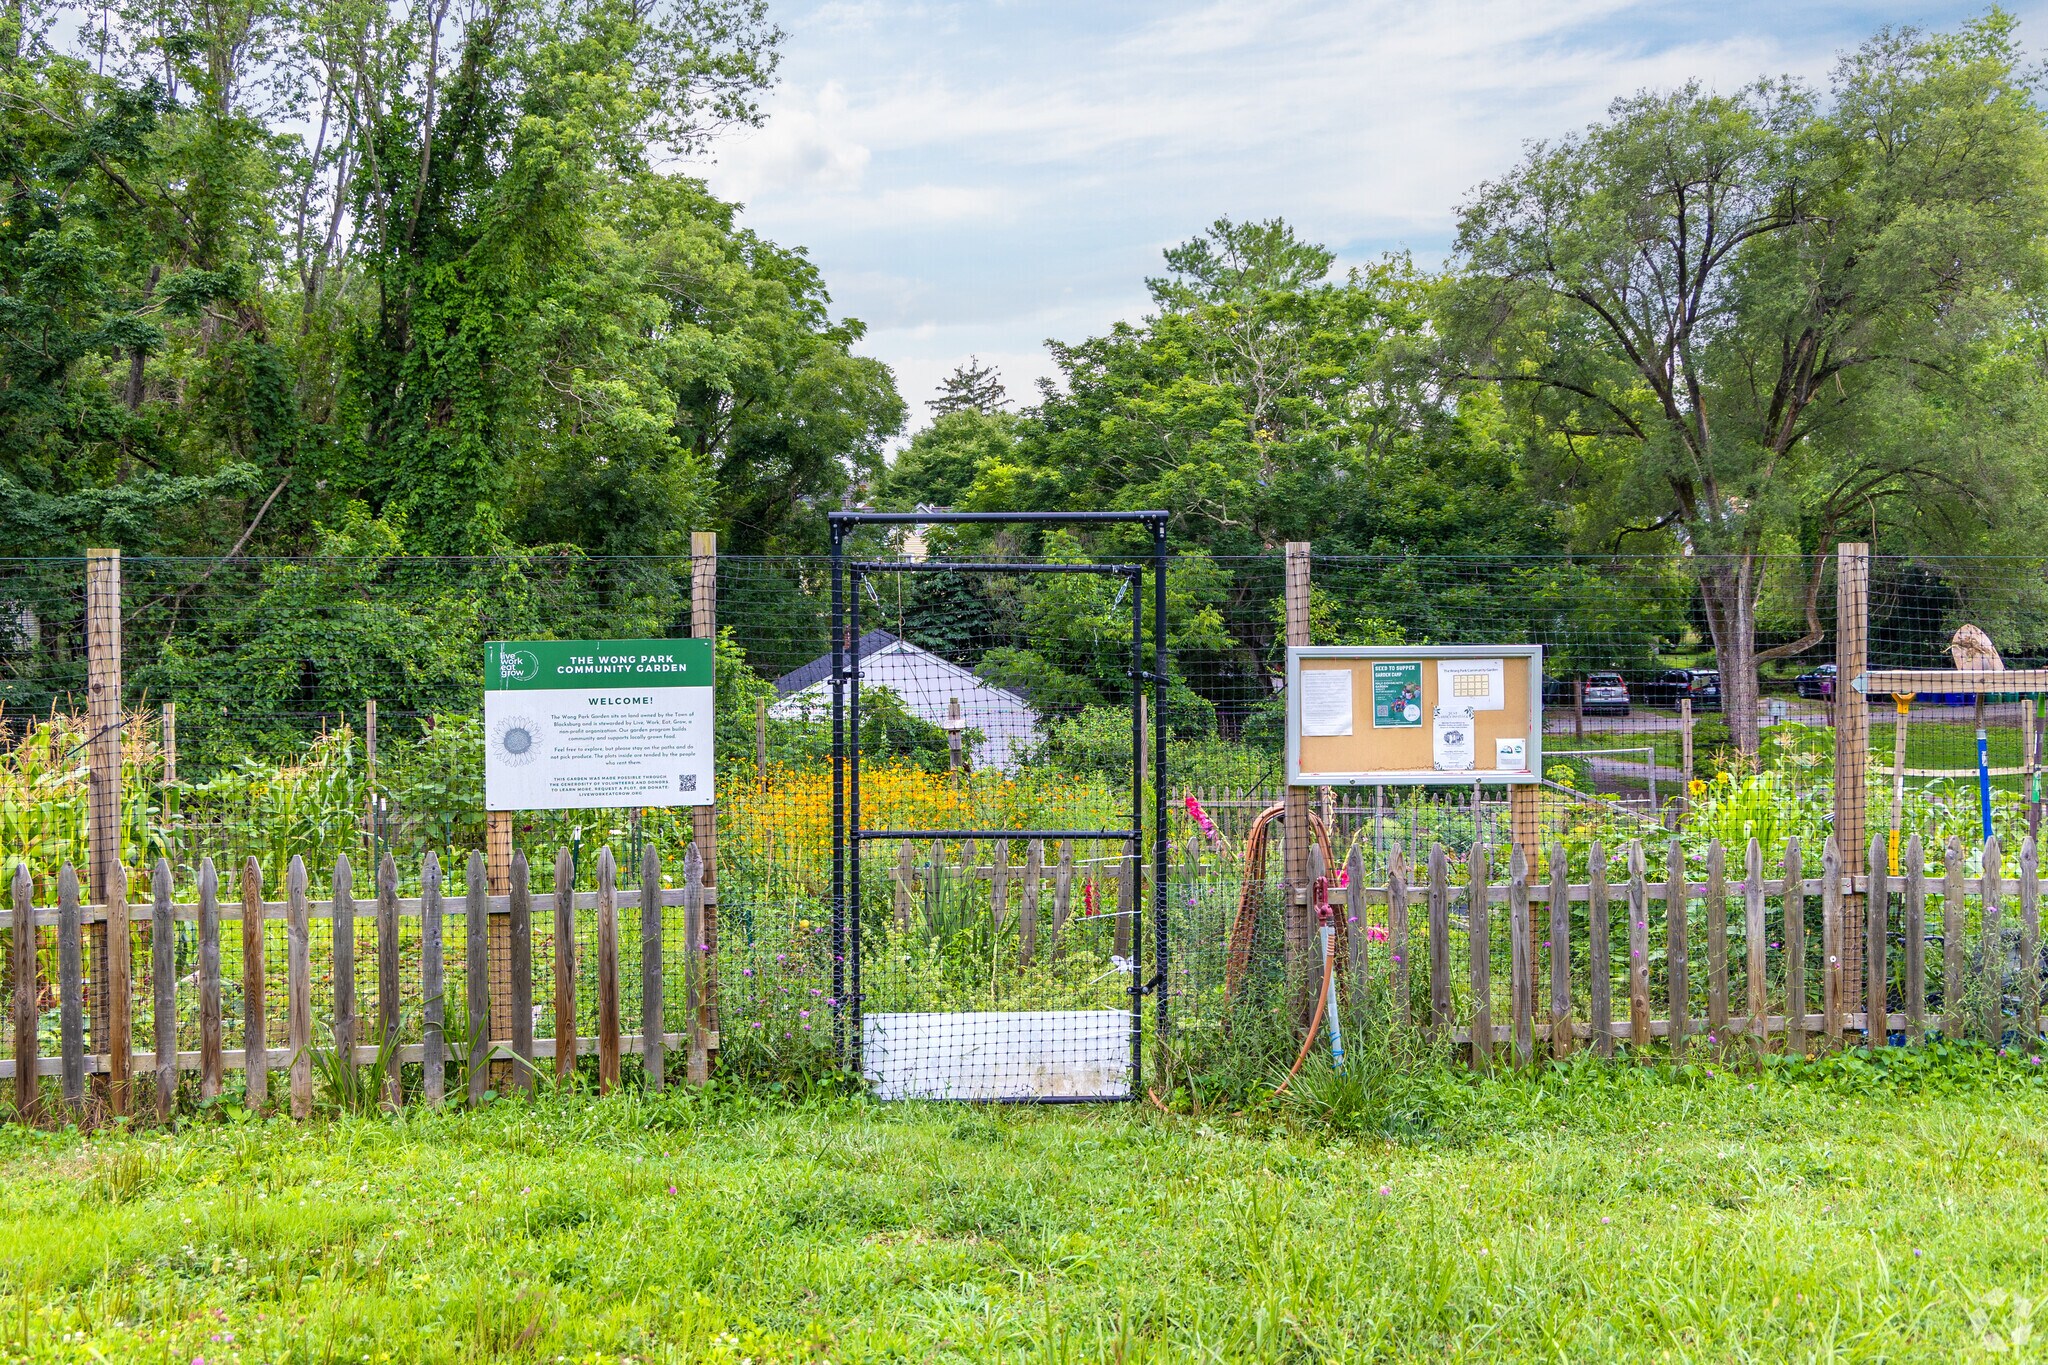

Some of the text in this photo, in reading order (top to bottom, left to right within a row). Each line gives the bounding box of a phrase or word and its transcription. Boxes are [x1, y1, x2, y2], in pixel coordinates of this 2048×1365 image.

[557, 664, 687, 673] COMMUNITY GARDEN
[589, 697, 653, 705] WELCOME!
